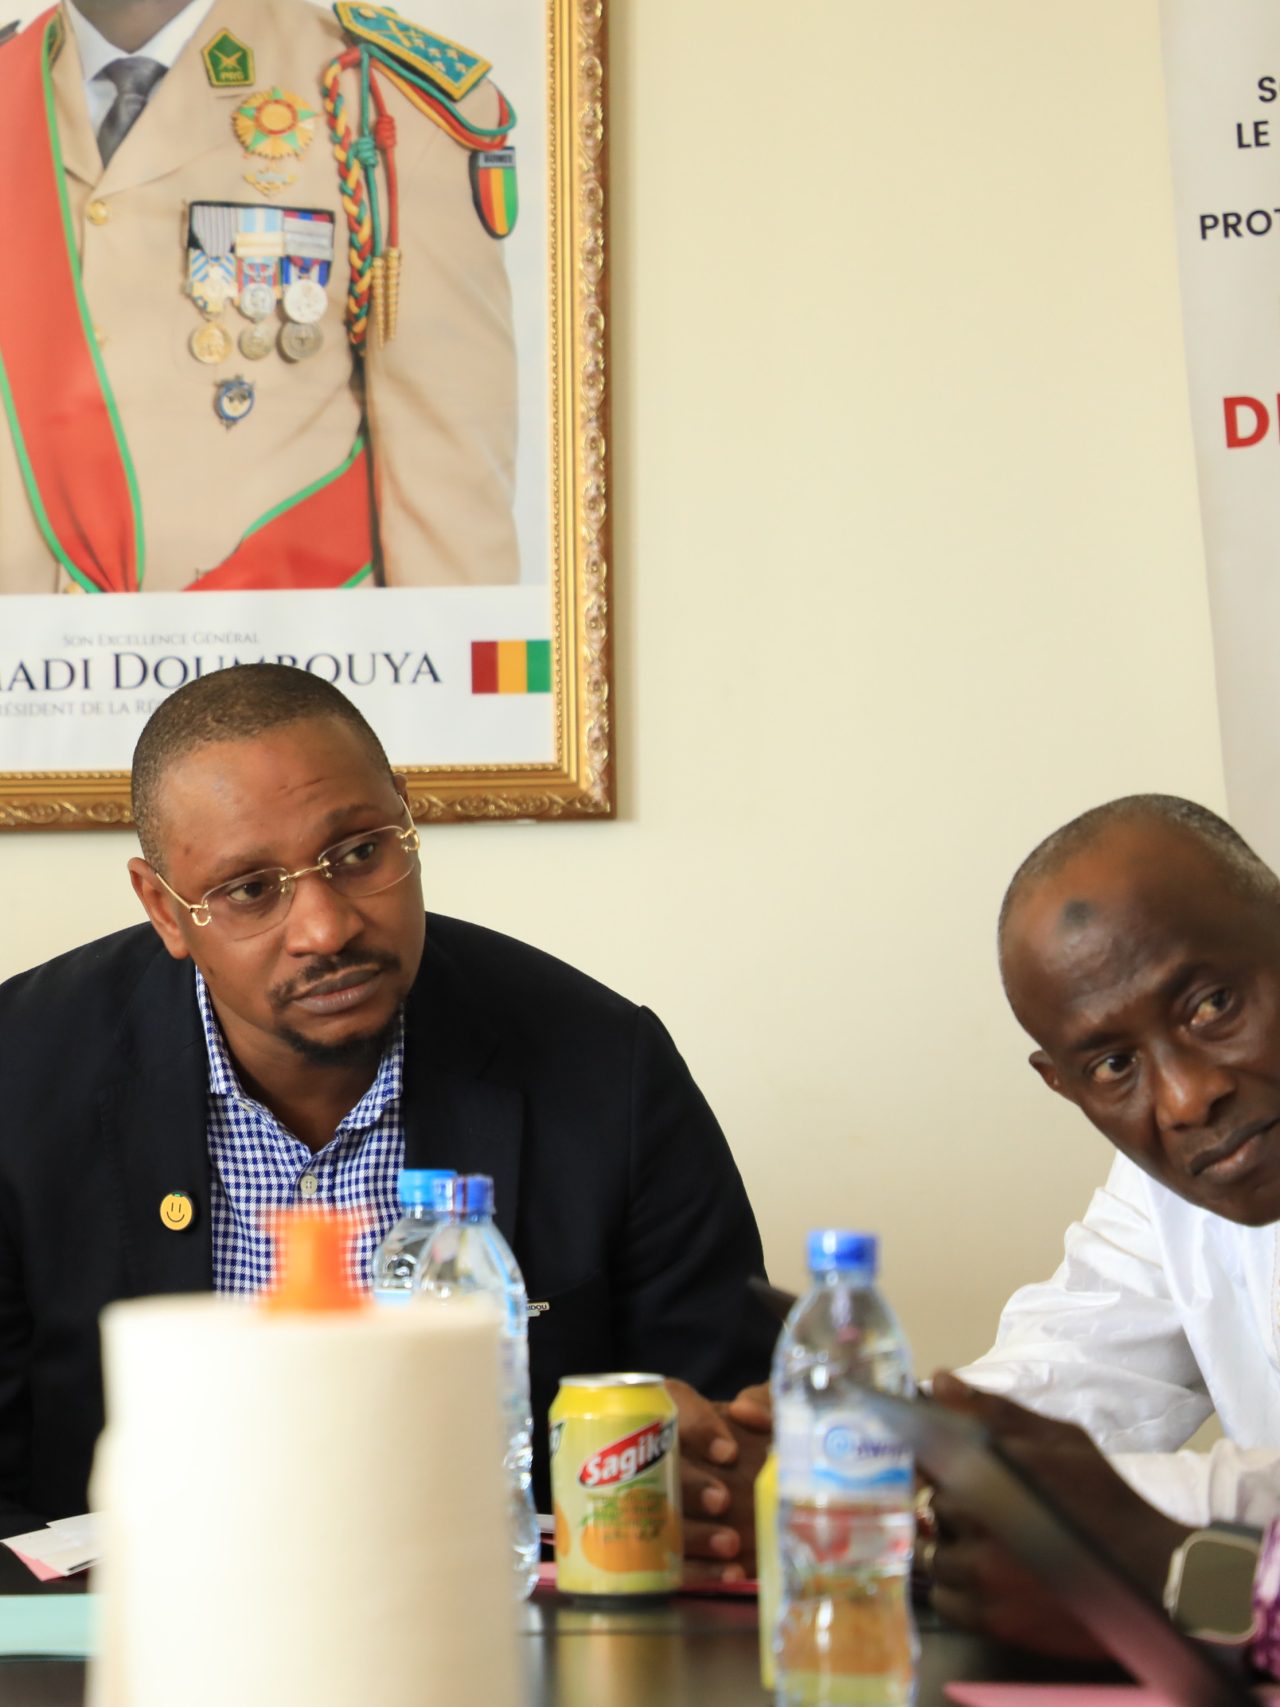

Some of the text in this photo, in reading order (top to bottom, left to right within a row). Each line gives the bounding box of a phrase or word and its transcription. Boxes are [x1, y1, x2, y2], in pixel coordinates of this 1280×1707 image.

[1258, 76, 1280, 103] S
[1237, 121, 1270, 149] LE
[1223, 394, 1280, 448] D
